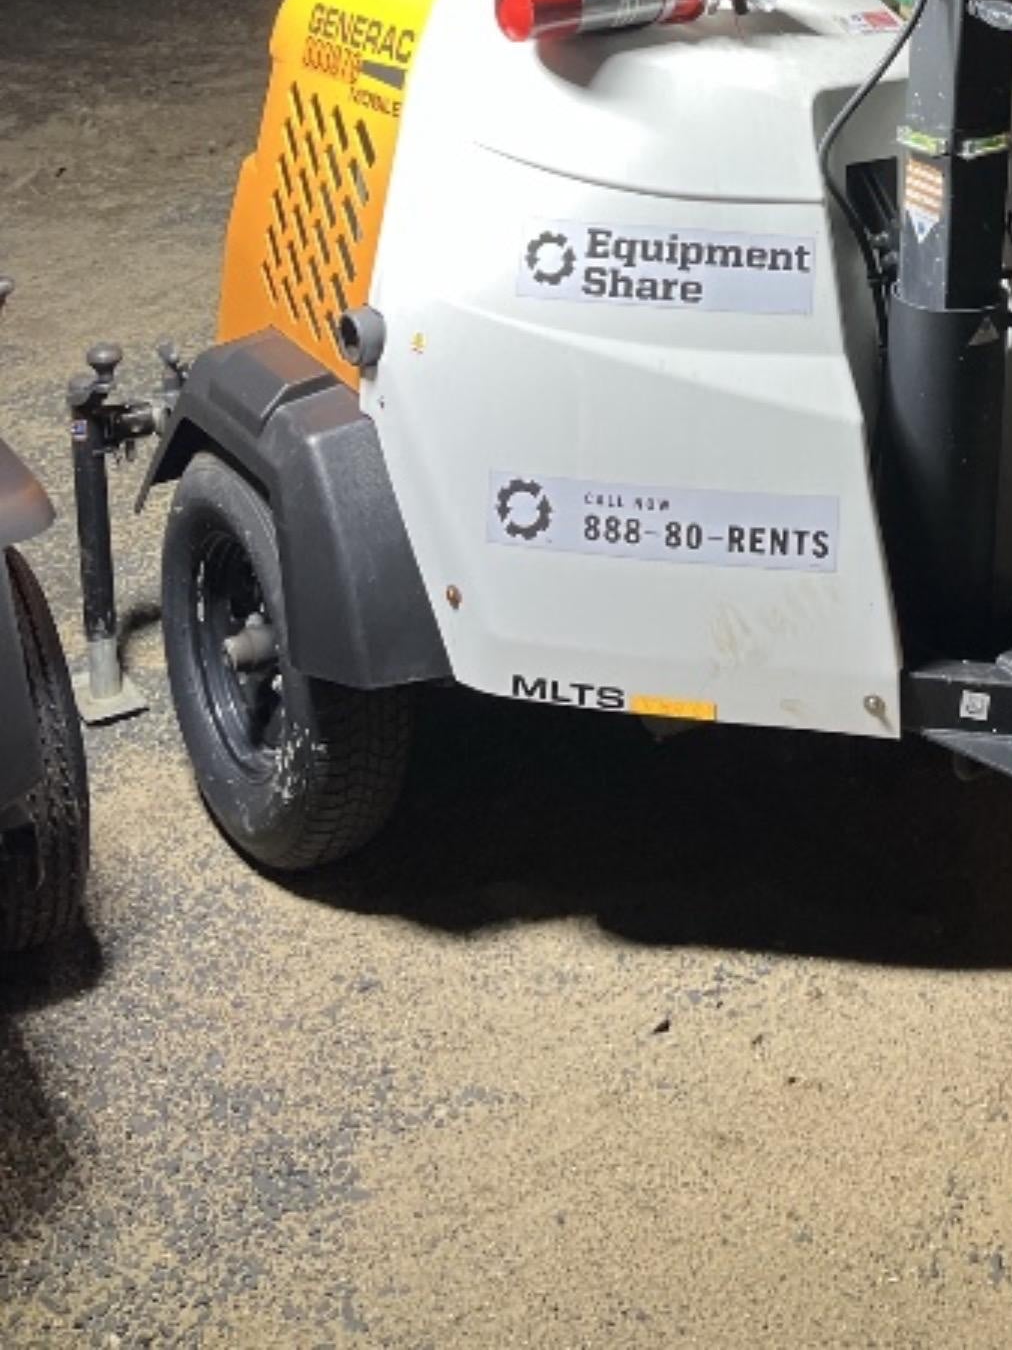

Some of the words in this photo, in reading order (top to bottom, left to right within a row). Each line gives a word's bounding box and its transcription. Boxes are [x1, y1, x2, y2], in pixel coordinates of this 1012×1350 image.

[307, 2, 415, 64] GENERAC
[585, 228, 811, 274] Equipment
[581, 266, 703, 303] Share
[583, 513, 830, 559] 888-80-RENTS
[511, 673, 626, 709] MLTS
